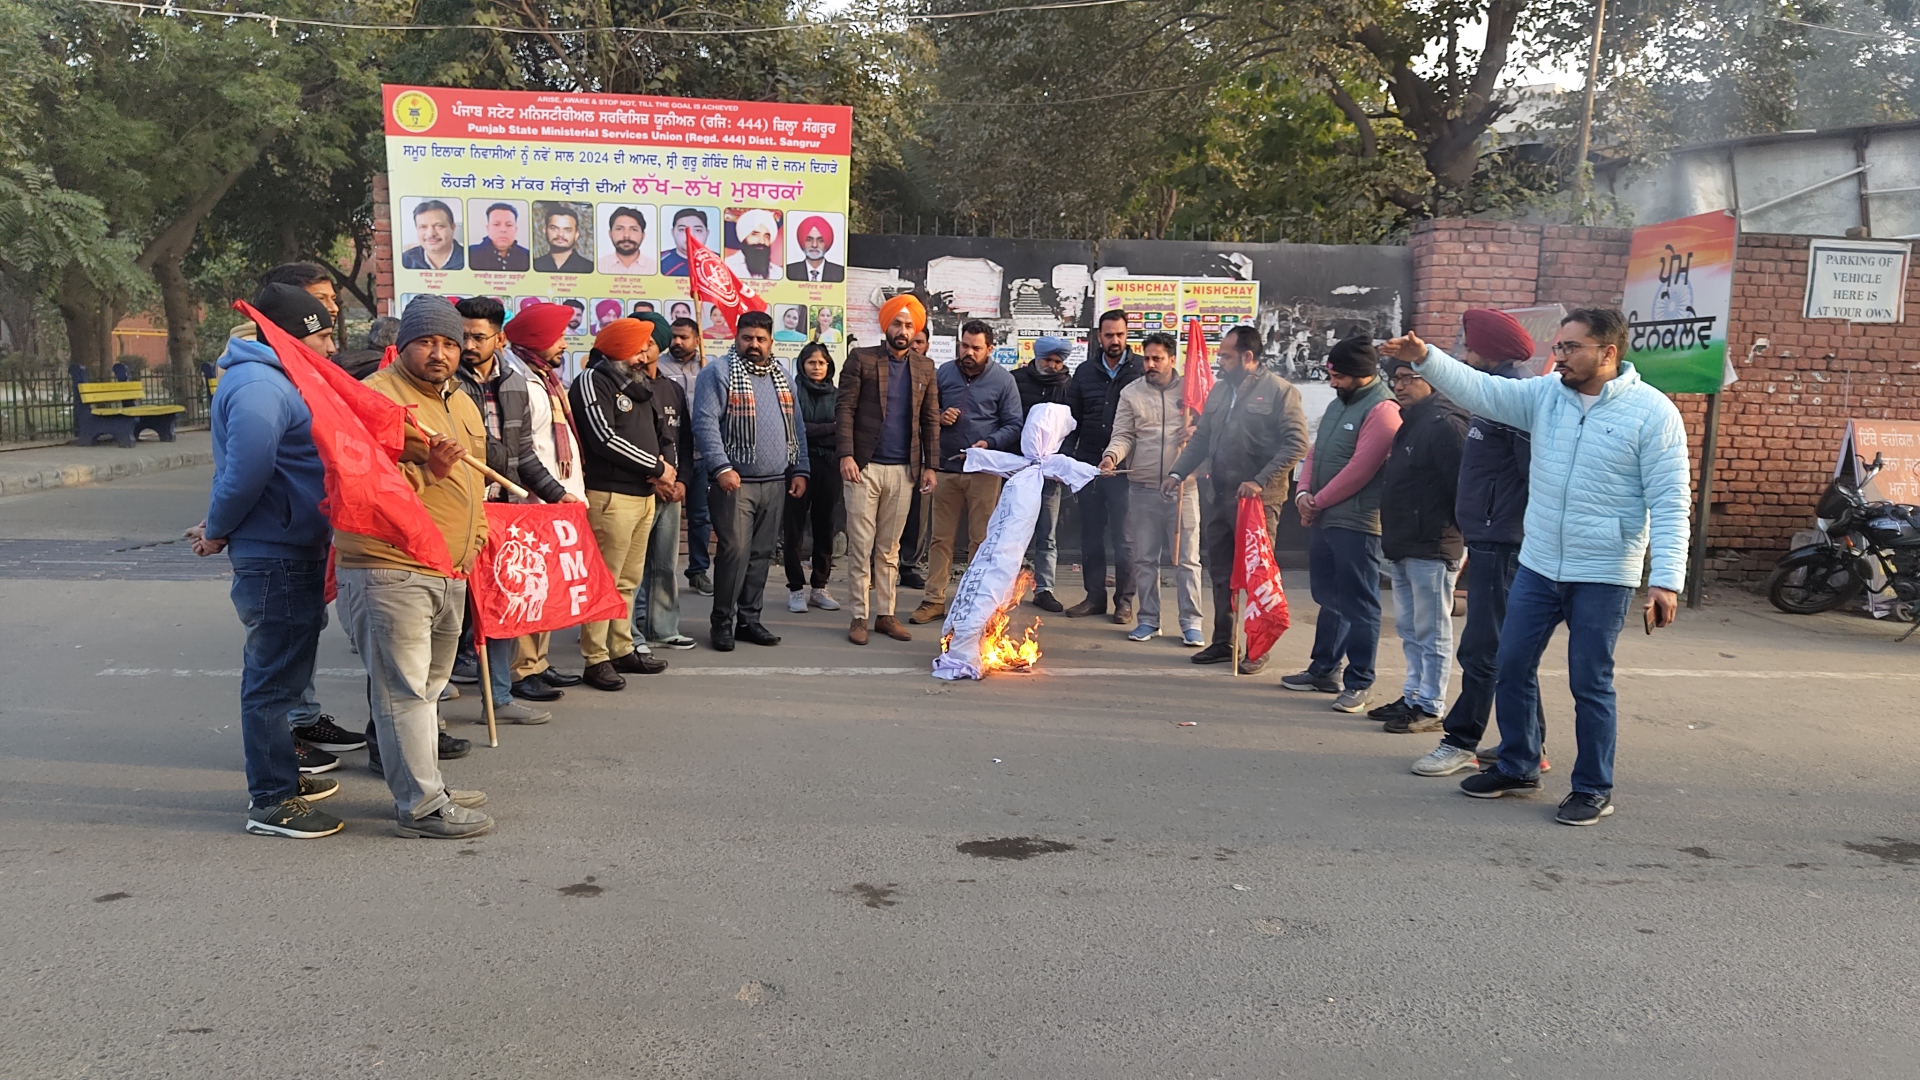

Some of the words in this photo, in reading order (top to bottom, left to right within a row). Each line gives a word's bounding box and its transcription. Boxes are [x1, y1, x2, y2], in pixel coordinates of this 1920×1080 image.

[537, 96, 562, 104] ARISE,
[598, 98, 618, 106] STOP
[702, 104, 739, 112] ACHIEVED
[452, 100, 483, 118] ਪੰਜਾਬ
[487, 103, 514, 119] ਸਟੇਟ
[654, 111, 696, 130] ਯੂਨੀਅਨ
[737, 117, 768, 132] 444)
[802, 118, 836, 138] ਸੰਗਰੂਰ
[468, 123, 505, 135] Punjab
[508, 125, 538, 136] State
[541, 126, 599, 138] Ministerial
[602, 128, 648, 140] Services
[651, 131, 682, 141] Union
[685, 132, 720, 145] (Regd.
[722, 134, 746, 146] 444)
[748, 135, 777, 146] Distt.
[779, 137, 821, 149] Sangrur
[403, 145, 427, 162] ਸਮੂਹ
[431, 143, 466, 158] ਇਲਾਕਾ
[470, 144, 516, 160] ਨਿਵਾਸੀਆਂ
[555, 149, 574, 163] ਸਾਲ
[579, 151, 609, 164] 2024
[614, 150, 625, 165] ਦੀ
[629, 154, 661, 168] ਆਮਦ,
[682, 155, 697, 172] ਗੁਰੂ
[702, 153, 728, 169] ਗੋਬਿੰਦ
[733, 155, 751, 170] ਸਿੰਘ
[756, 156, 767, 171] ਜੀ
[771, 158, 779, 171] ਦੇ
[783, 160, 806, 173] ਜਨਮ
[810, 157, 838, 174] ਦਿਹਾੜੇ
[441, 172, 477, 189] ਲੋਹੜੀ
[483, 175, 505, 190] ਅਤੇ
[596, 179, 626, 194] ਦੀਆਂ
[731, 180, 804, 203] ਮੁਬਾਰਕਾਂ
[1826, 254, 1876, 266] PARKING
[1878, 257, 1894, 267] OF
[1116, 283, 1177, 292] NISHCHAY
[1833, 272, 1882, 284] VEHICLE
[1193, 286, 1254, 294] NISHCHAY
[1833, 290, 1864, 300] HERE
[1867, 291, 1878, 301] IS
[1814, 306, 1830, 316] AT
[1834, 306, 1862, 318] YOUR
[1866, 308, 1892, 318] OWN
[303, 313, 322, 334] NIKE
[1628, 306, 1716, 352] ਇਨਕਲੇਵ
[1881, 428, 1914, 447] ਵਹੀਕਲ
[1910, 476, 1918, 496] ਹੈ
[552, 519, 588, 616] DMF
